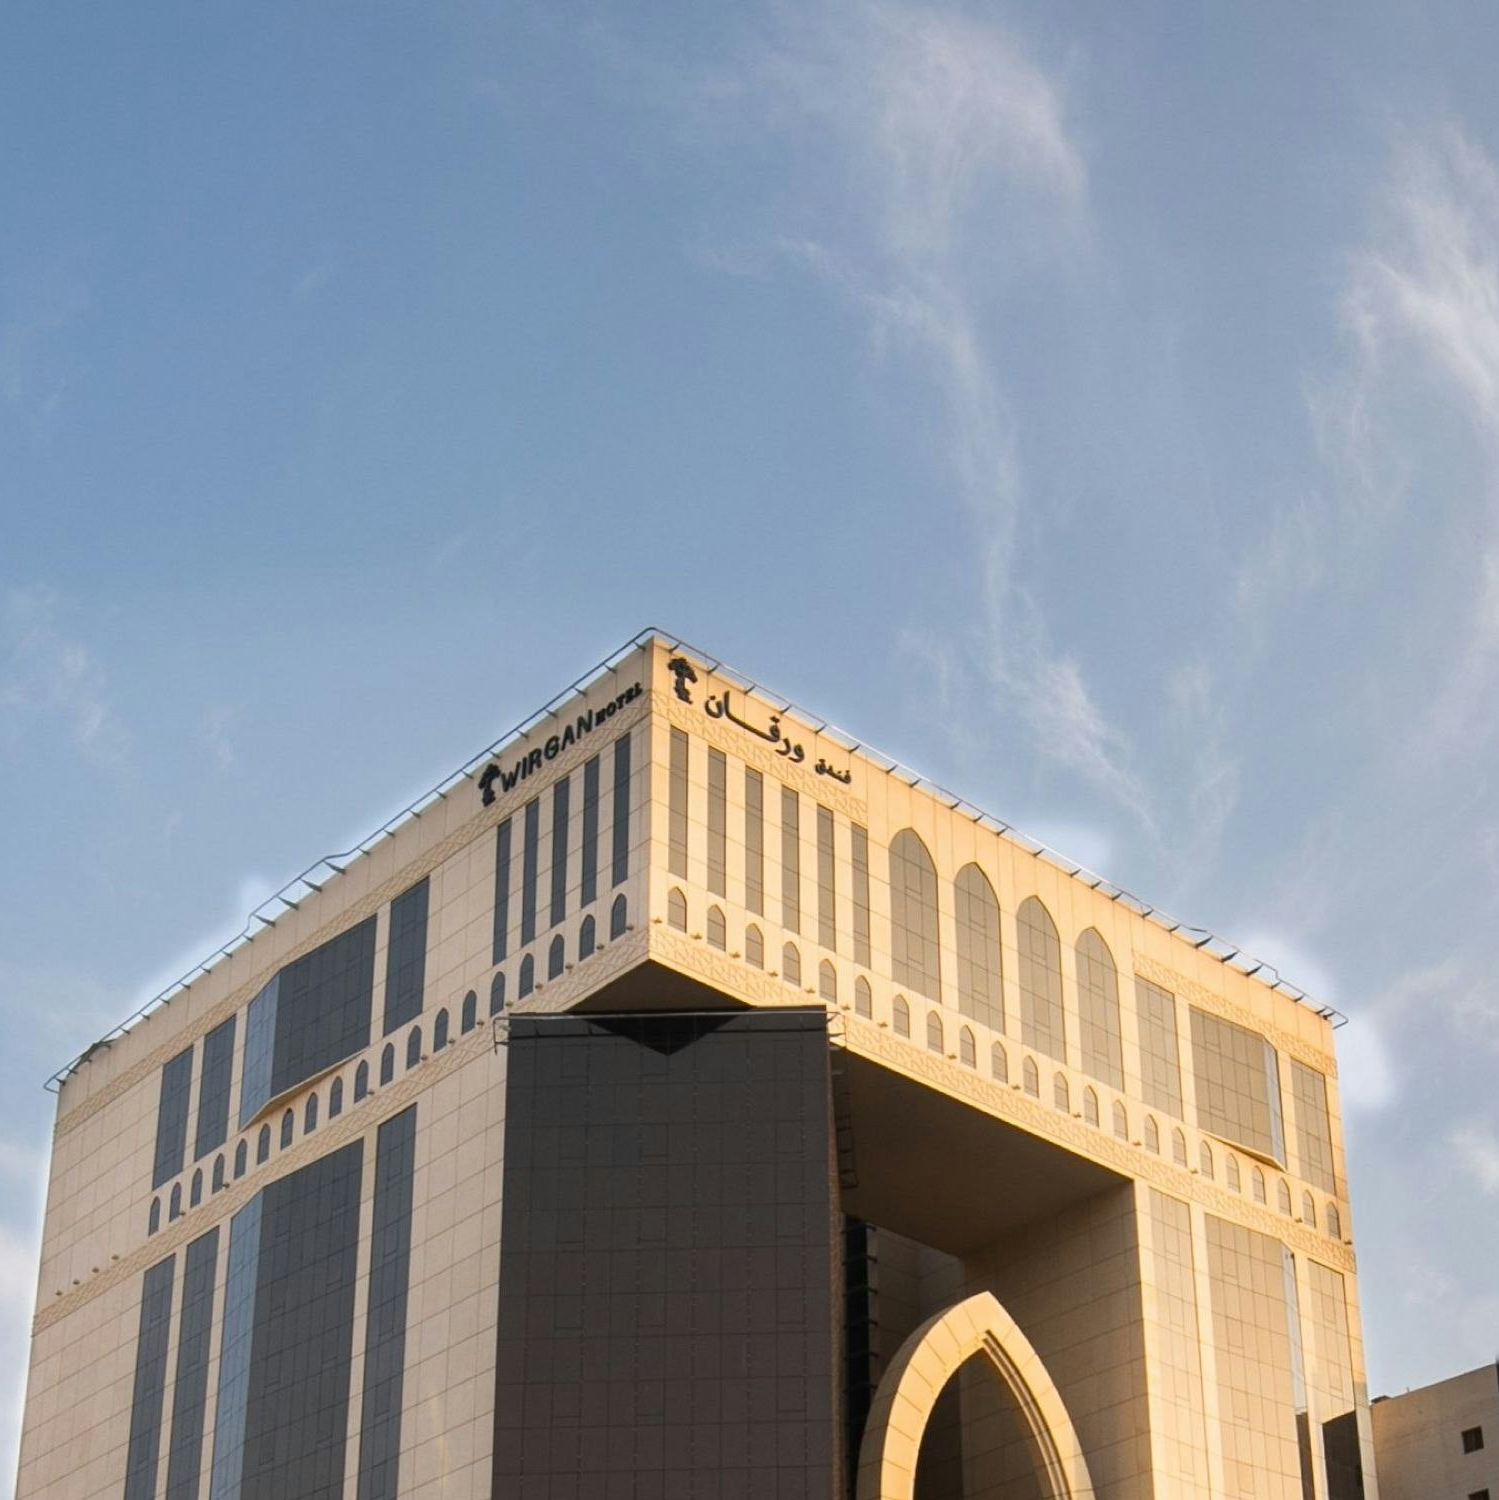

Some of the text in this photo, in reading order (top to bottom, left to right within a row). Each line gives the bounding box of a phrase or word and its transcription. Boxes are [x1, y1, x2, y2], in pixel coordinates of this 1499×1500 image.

[501, 682, 643, 793] WIRGAN HOTEL
[705, 688, 852, 784] فندق ورقان
